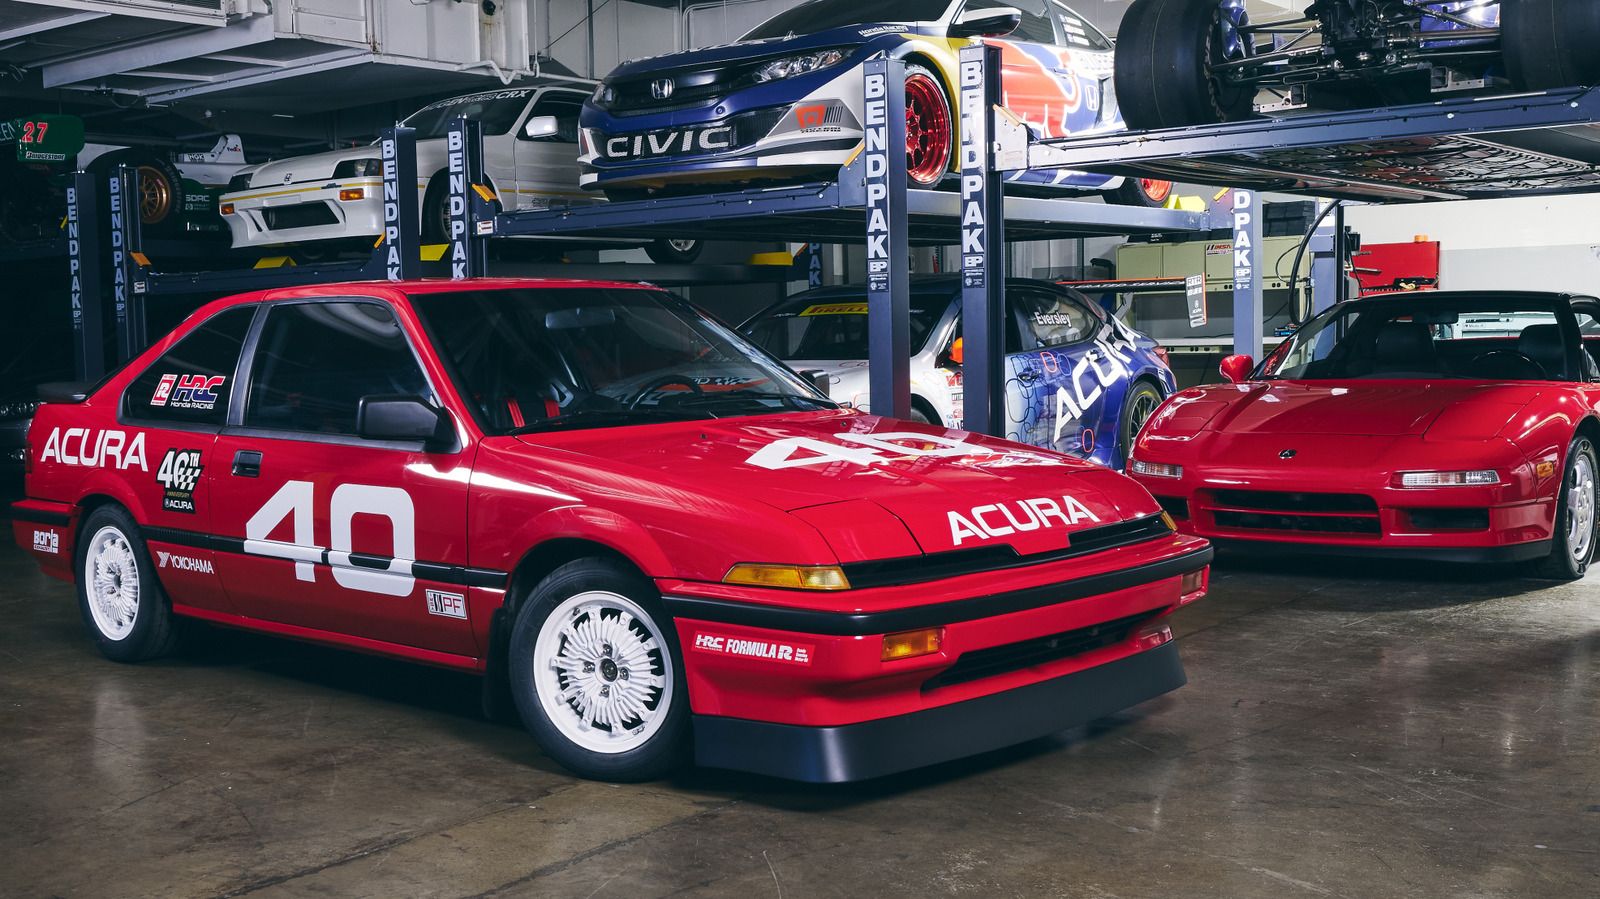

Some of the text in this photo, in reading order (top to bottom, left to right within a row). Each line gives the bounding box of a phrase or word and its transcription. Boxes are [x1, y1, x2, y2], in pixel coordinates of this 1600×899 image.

[495, 90, 530, 100] CRX
[22, 121, 48, 143] 27
[606, 126, 732, 158] CIVIC
[865, 74, 889, 259] BENDPAK
[382, 139, 402, 282] BENDPAK
[448, 131, 466, 280] BENDPAK
[66, 187, 82, 309] BENDPAK
[109, 177, 125, 302] BENDPAK
[811, 303, 867, 314] PIRELL
[1034, 311, 1072, 328] Eversley
[171, 374, 226, 403] HRC
[1053, 313, 1142, 444] ACURA
[170, 401, 190, 409] Honda
[190, 402, 214, 410] RACING
[41, 426, 149, 472] ACURA
[169, 499, 193, 510] ACURA
[946, 494, 1100, 546] ACURA
[243, 480, 416, 597] 40
[170, 554, 214, 574] YOKOHAMA
[695, 634, 725, 649] HRC
[725, 638, 777, 659] FORMULA
